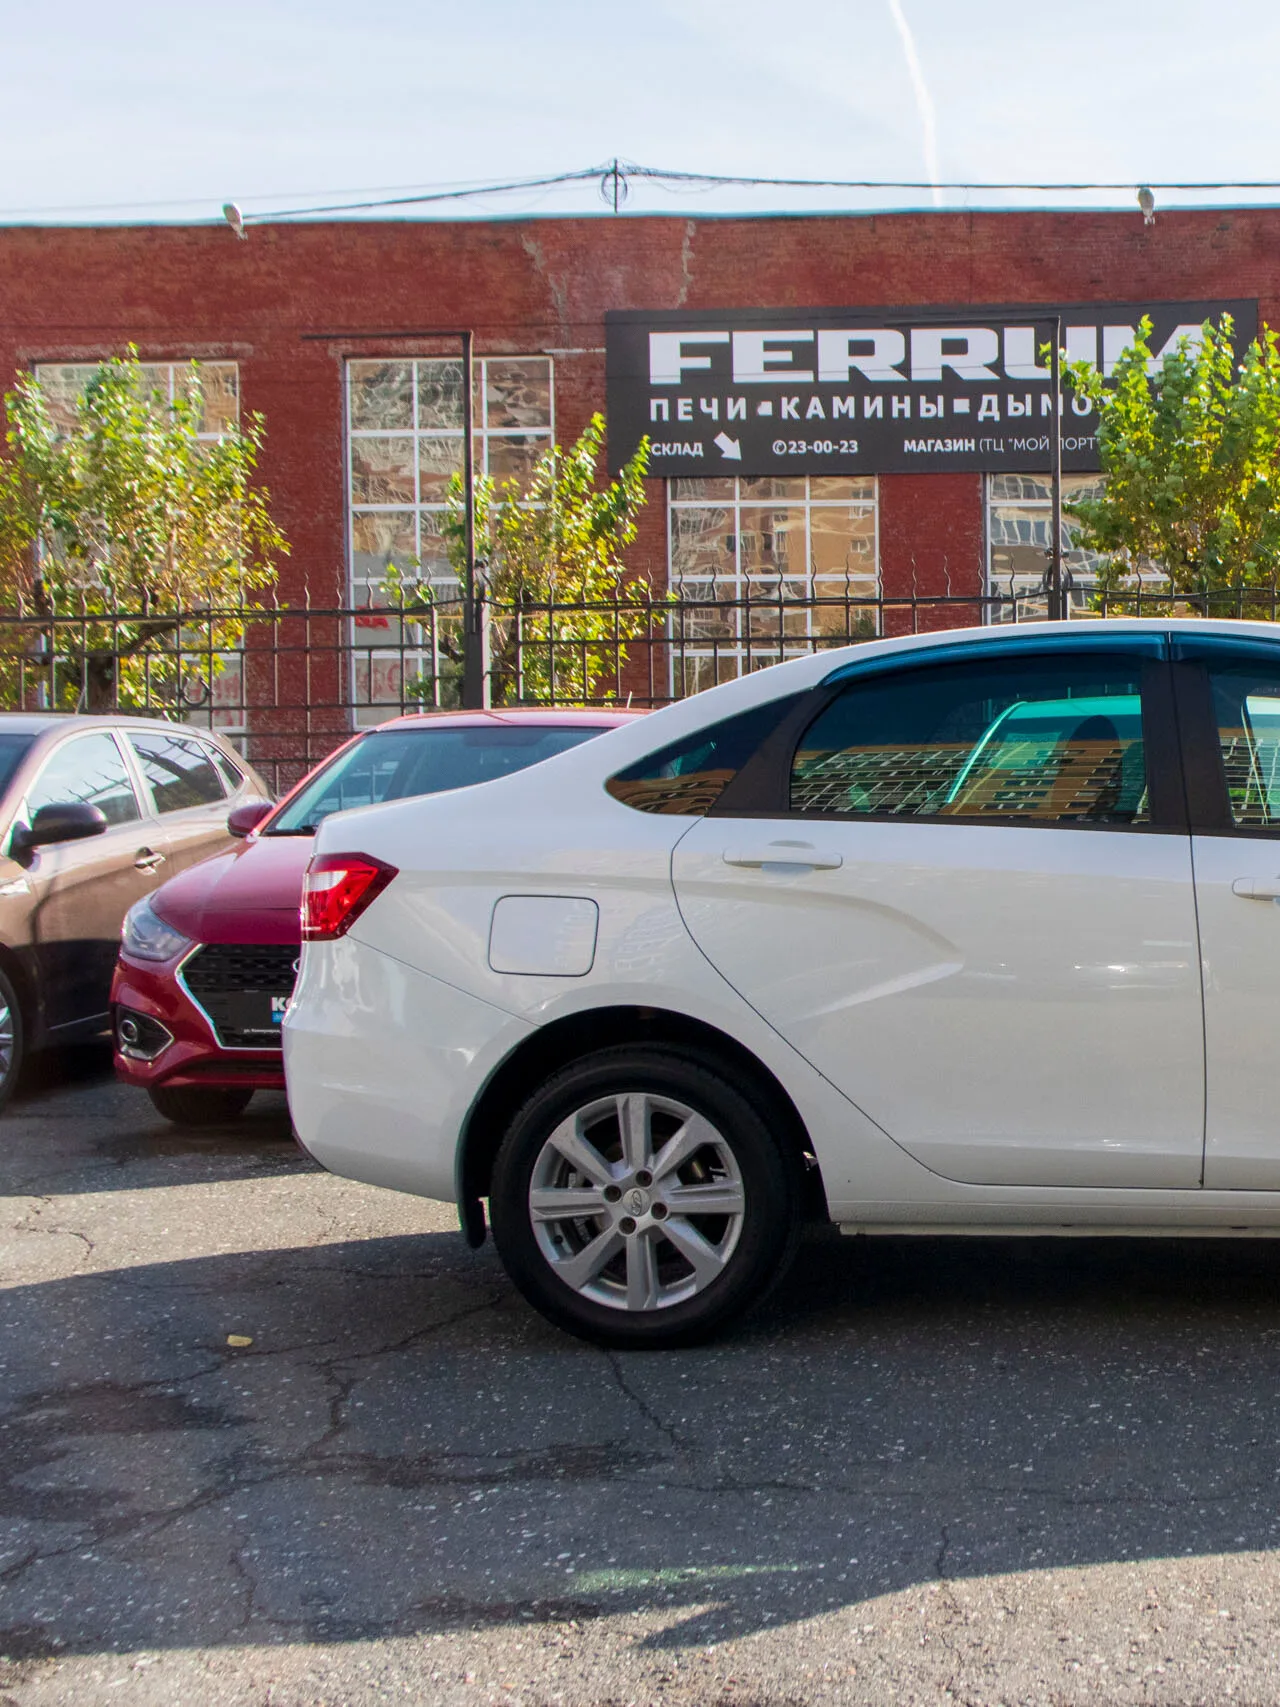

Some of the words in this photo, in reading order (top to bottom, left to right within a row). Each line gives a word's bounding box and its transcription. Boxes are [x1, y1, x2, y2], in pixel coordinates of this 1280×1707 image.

[650, 398, 747, 421] ПЕЧИ
[781, 395, 945, 420] КАМИНЫ
[651, 442, 704, 457] СКЛАД
[904, 438, 975, 453] МАГАЗИН
[979, 437, 1004, 453] (ТЦ
